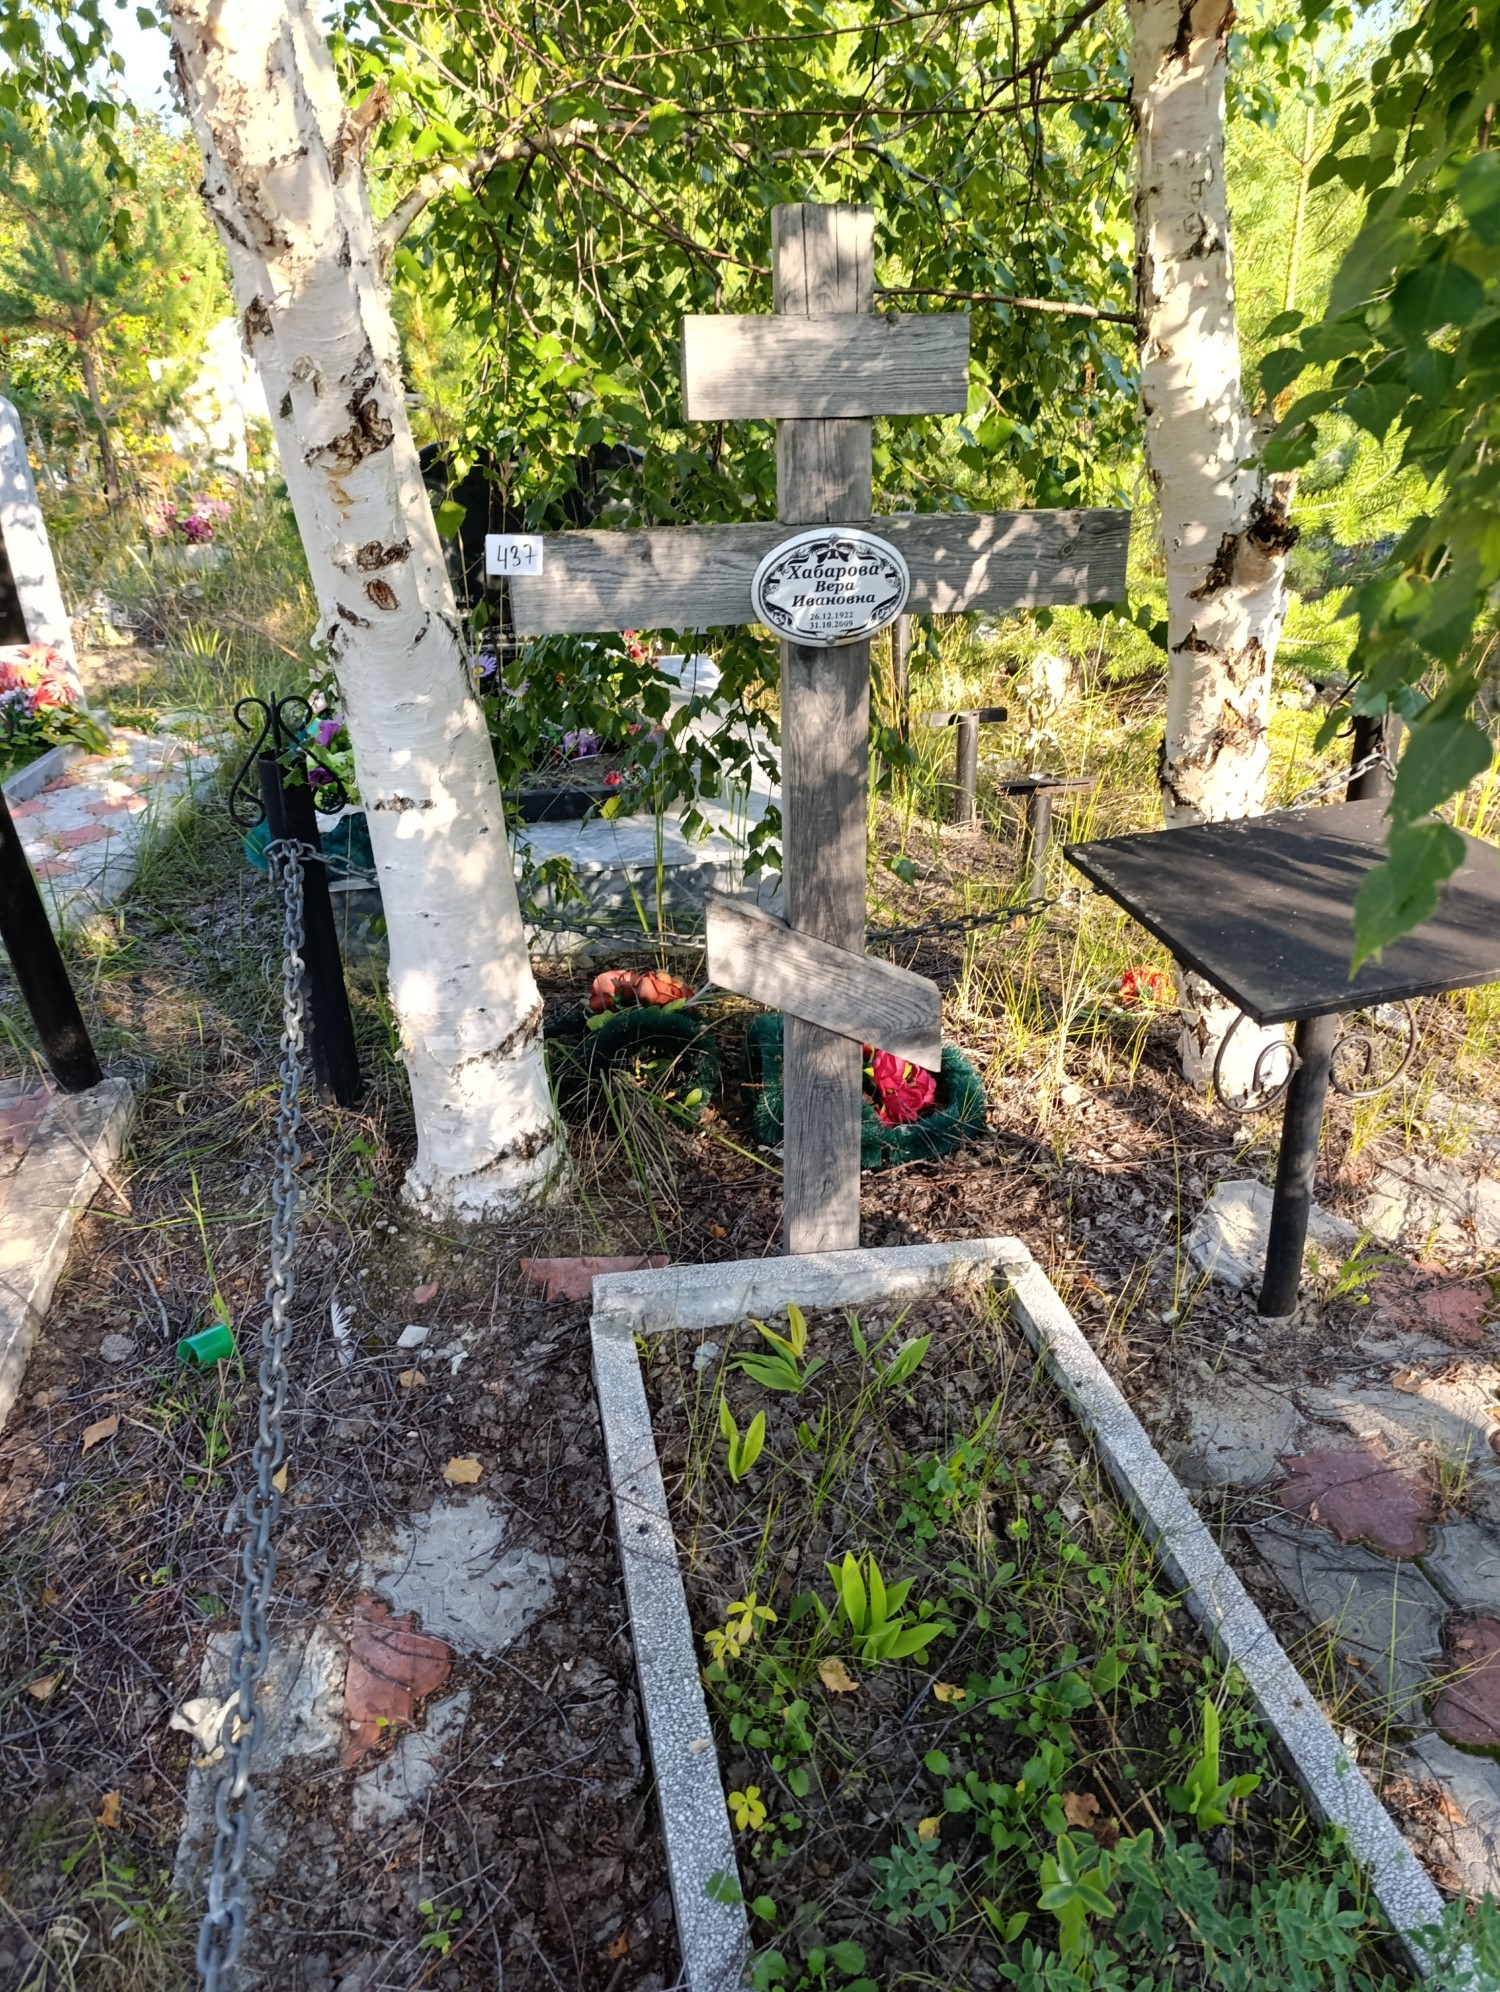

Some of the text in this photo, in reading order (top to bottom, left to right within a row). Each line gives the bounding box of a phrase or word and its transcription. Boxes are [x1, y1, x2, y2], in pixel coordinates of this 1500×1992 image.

[497, 544, 537, 570] 437
[787, 564, 880, 581] Хабарова
[814, 581, 855, 594] Вера
[791, 594, 876, 607] Ивановна
[810, 611, 854, 621] 26.12.1922
[809, 620, 854, 629] 31.10.2009
